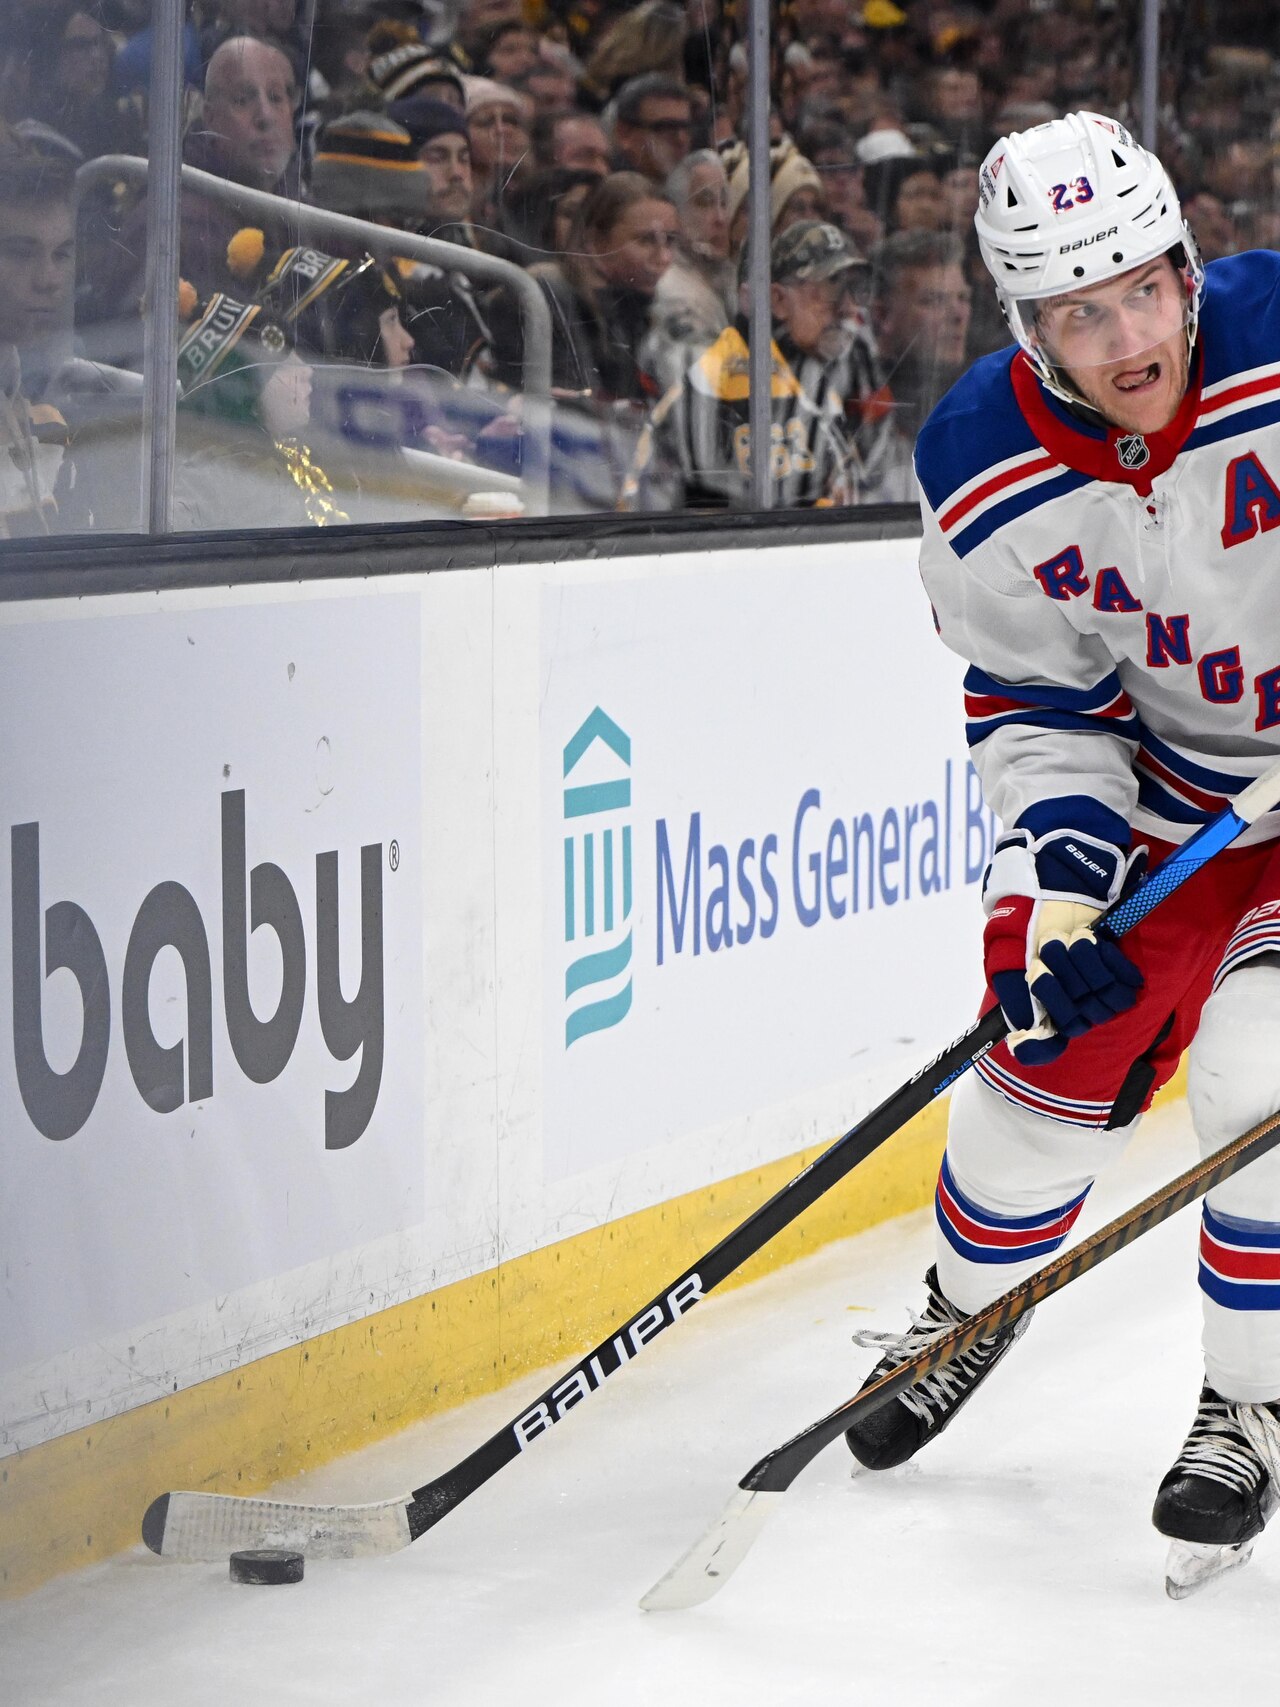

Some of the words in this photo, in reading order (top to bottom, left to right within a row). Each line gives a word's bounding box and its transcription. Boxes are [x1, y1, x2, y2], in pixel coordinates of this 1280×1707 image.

[1048, 177, 1094, 214] 23
[1124, 442, 1141, 464] NHL
[655, 812, 779, 967] Mass
[792, 758, 953, 929] General
[11, 788, 387, 1150] baby
[933, 1058, 973, 1095] NEXUS
[971, 1040, 994, 1062] GEO
